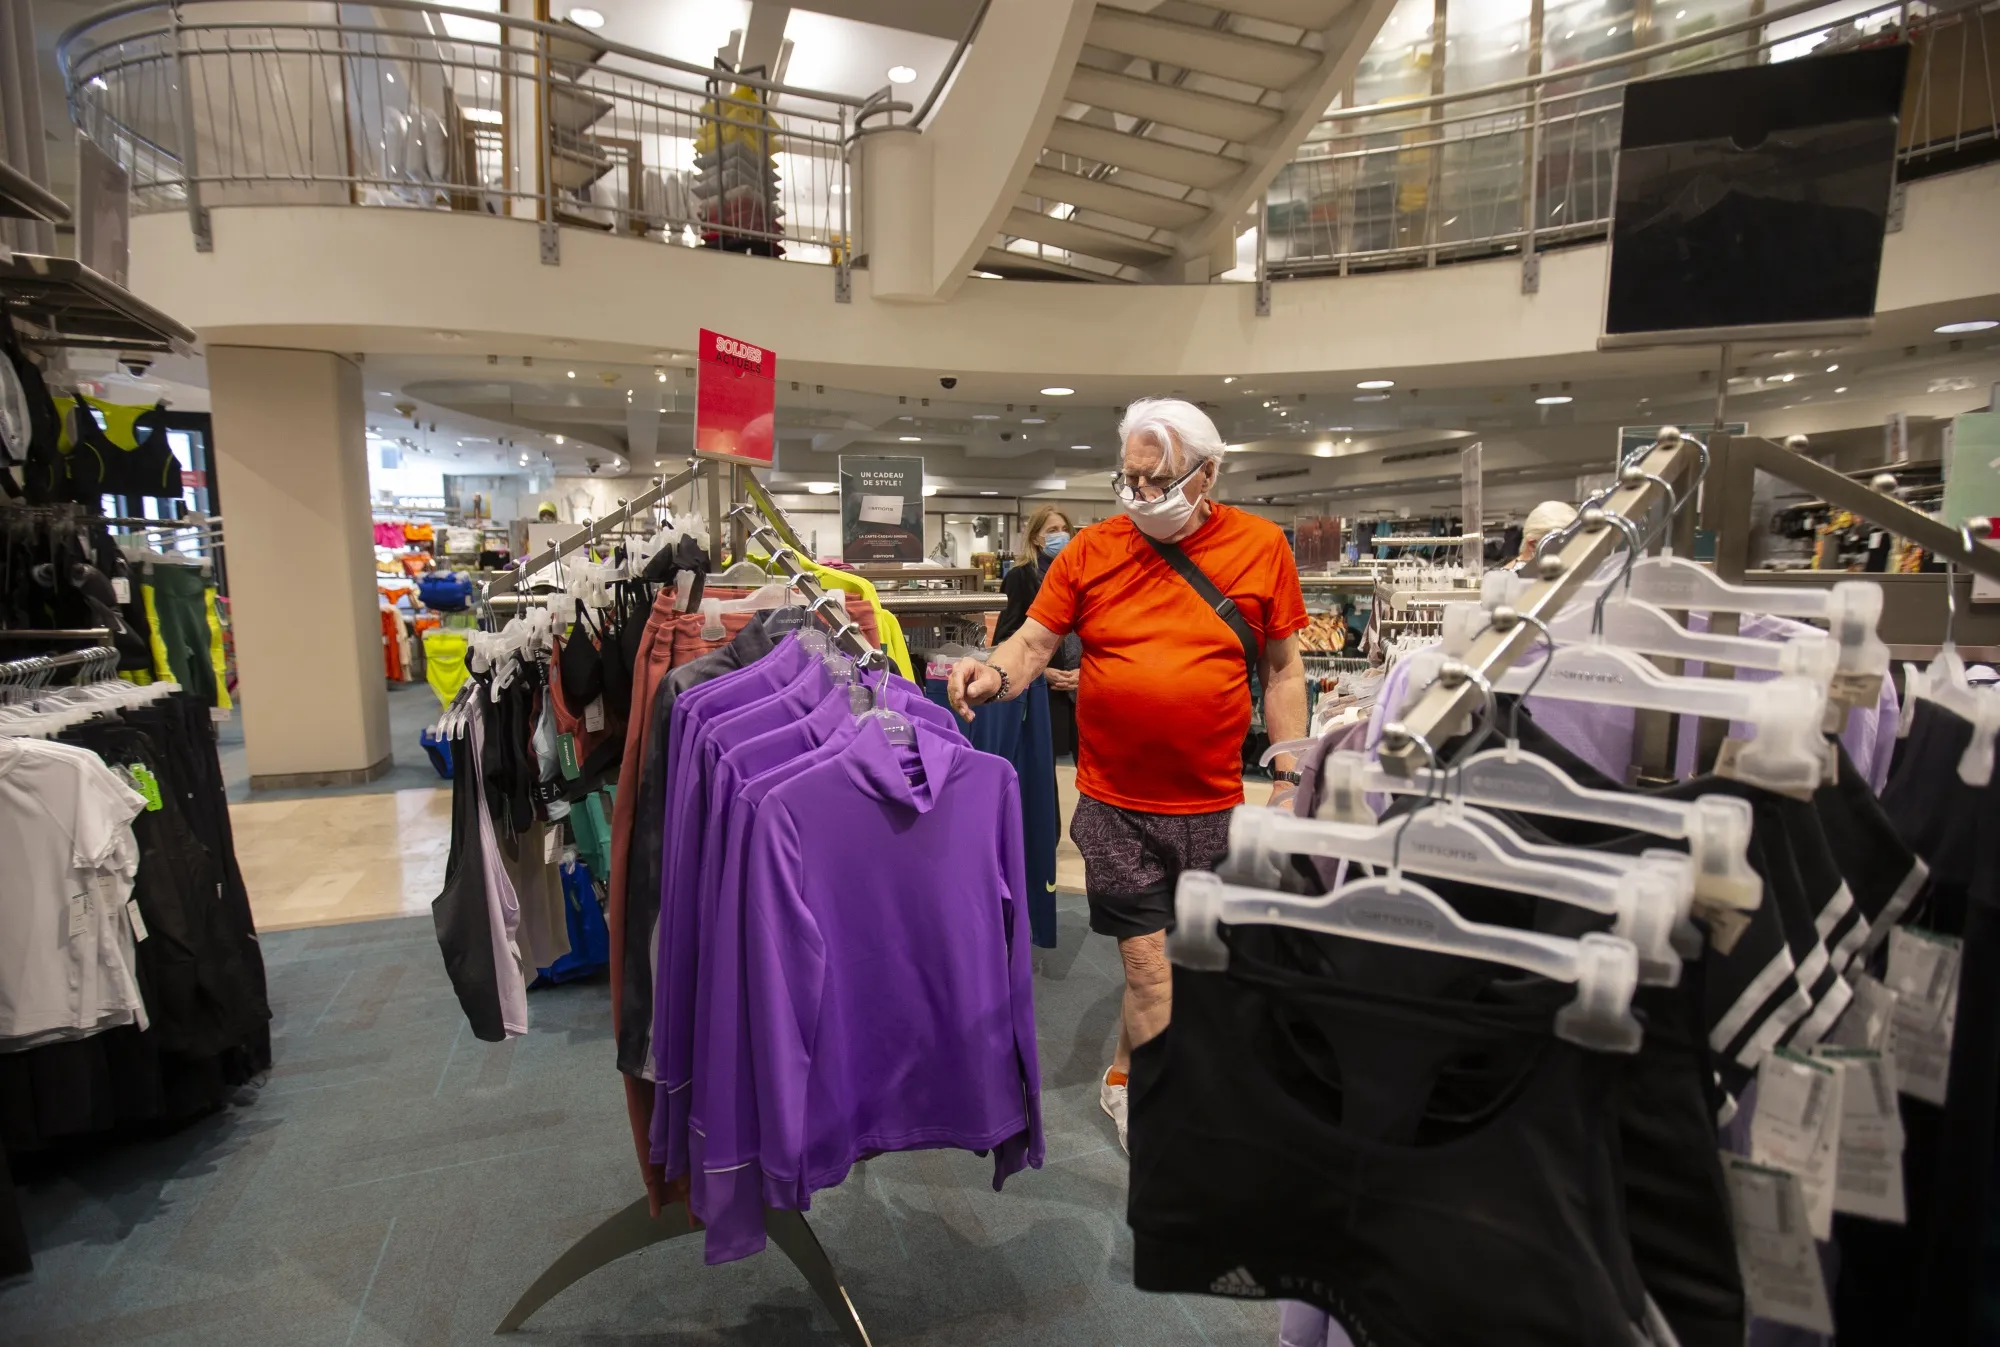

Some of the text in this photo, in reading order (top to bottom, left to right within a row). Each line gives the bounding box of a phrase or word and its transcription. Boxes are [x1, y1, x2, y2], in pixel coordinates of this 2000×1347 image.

[716, 337, 762, 363] SOLDES
[716, 352, 761, 373] ACTUELS
[1209, 1282, 1266, 1296] adidas
